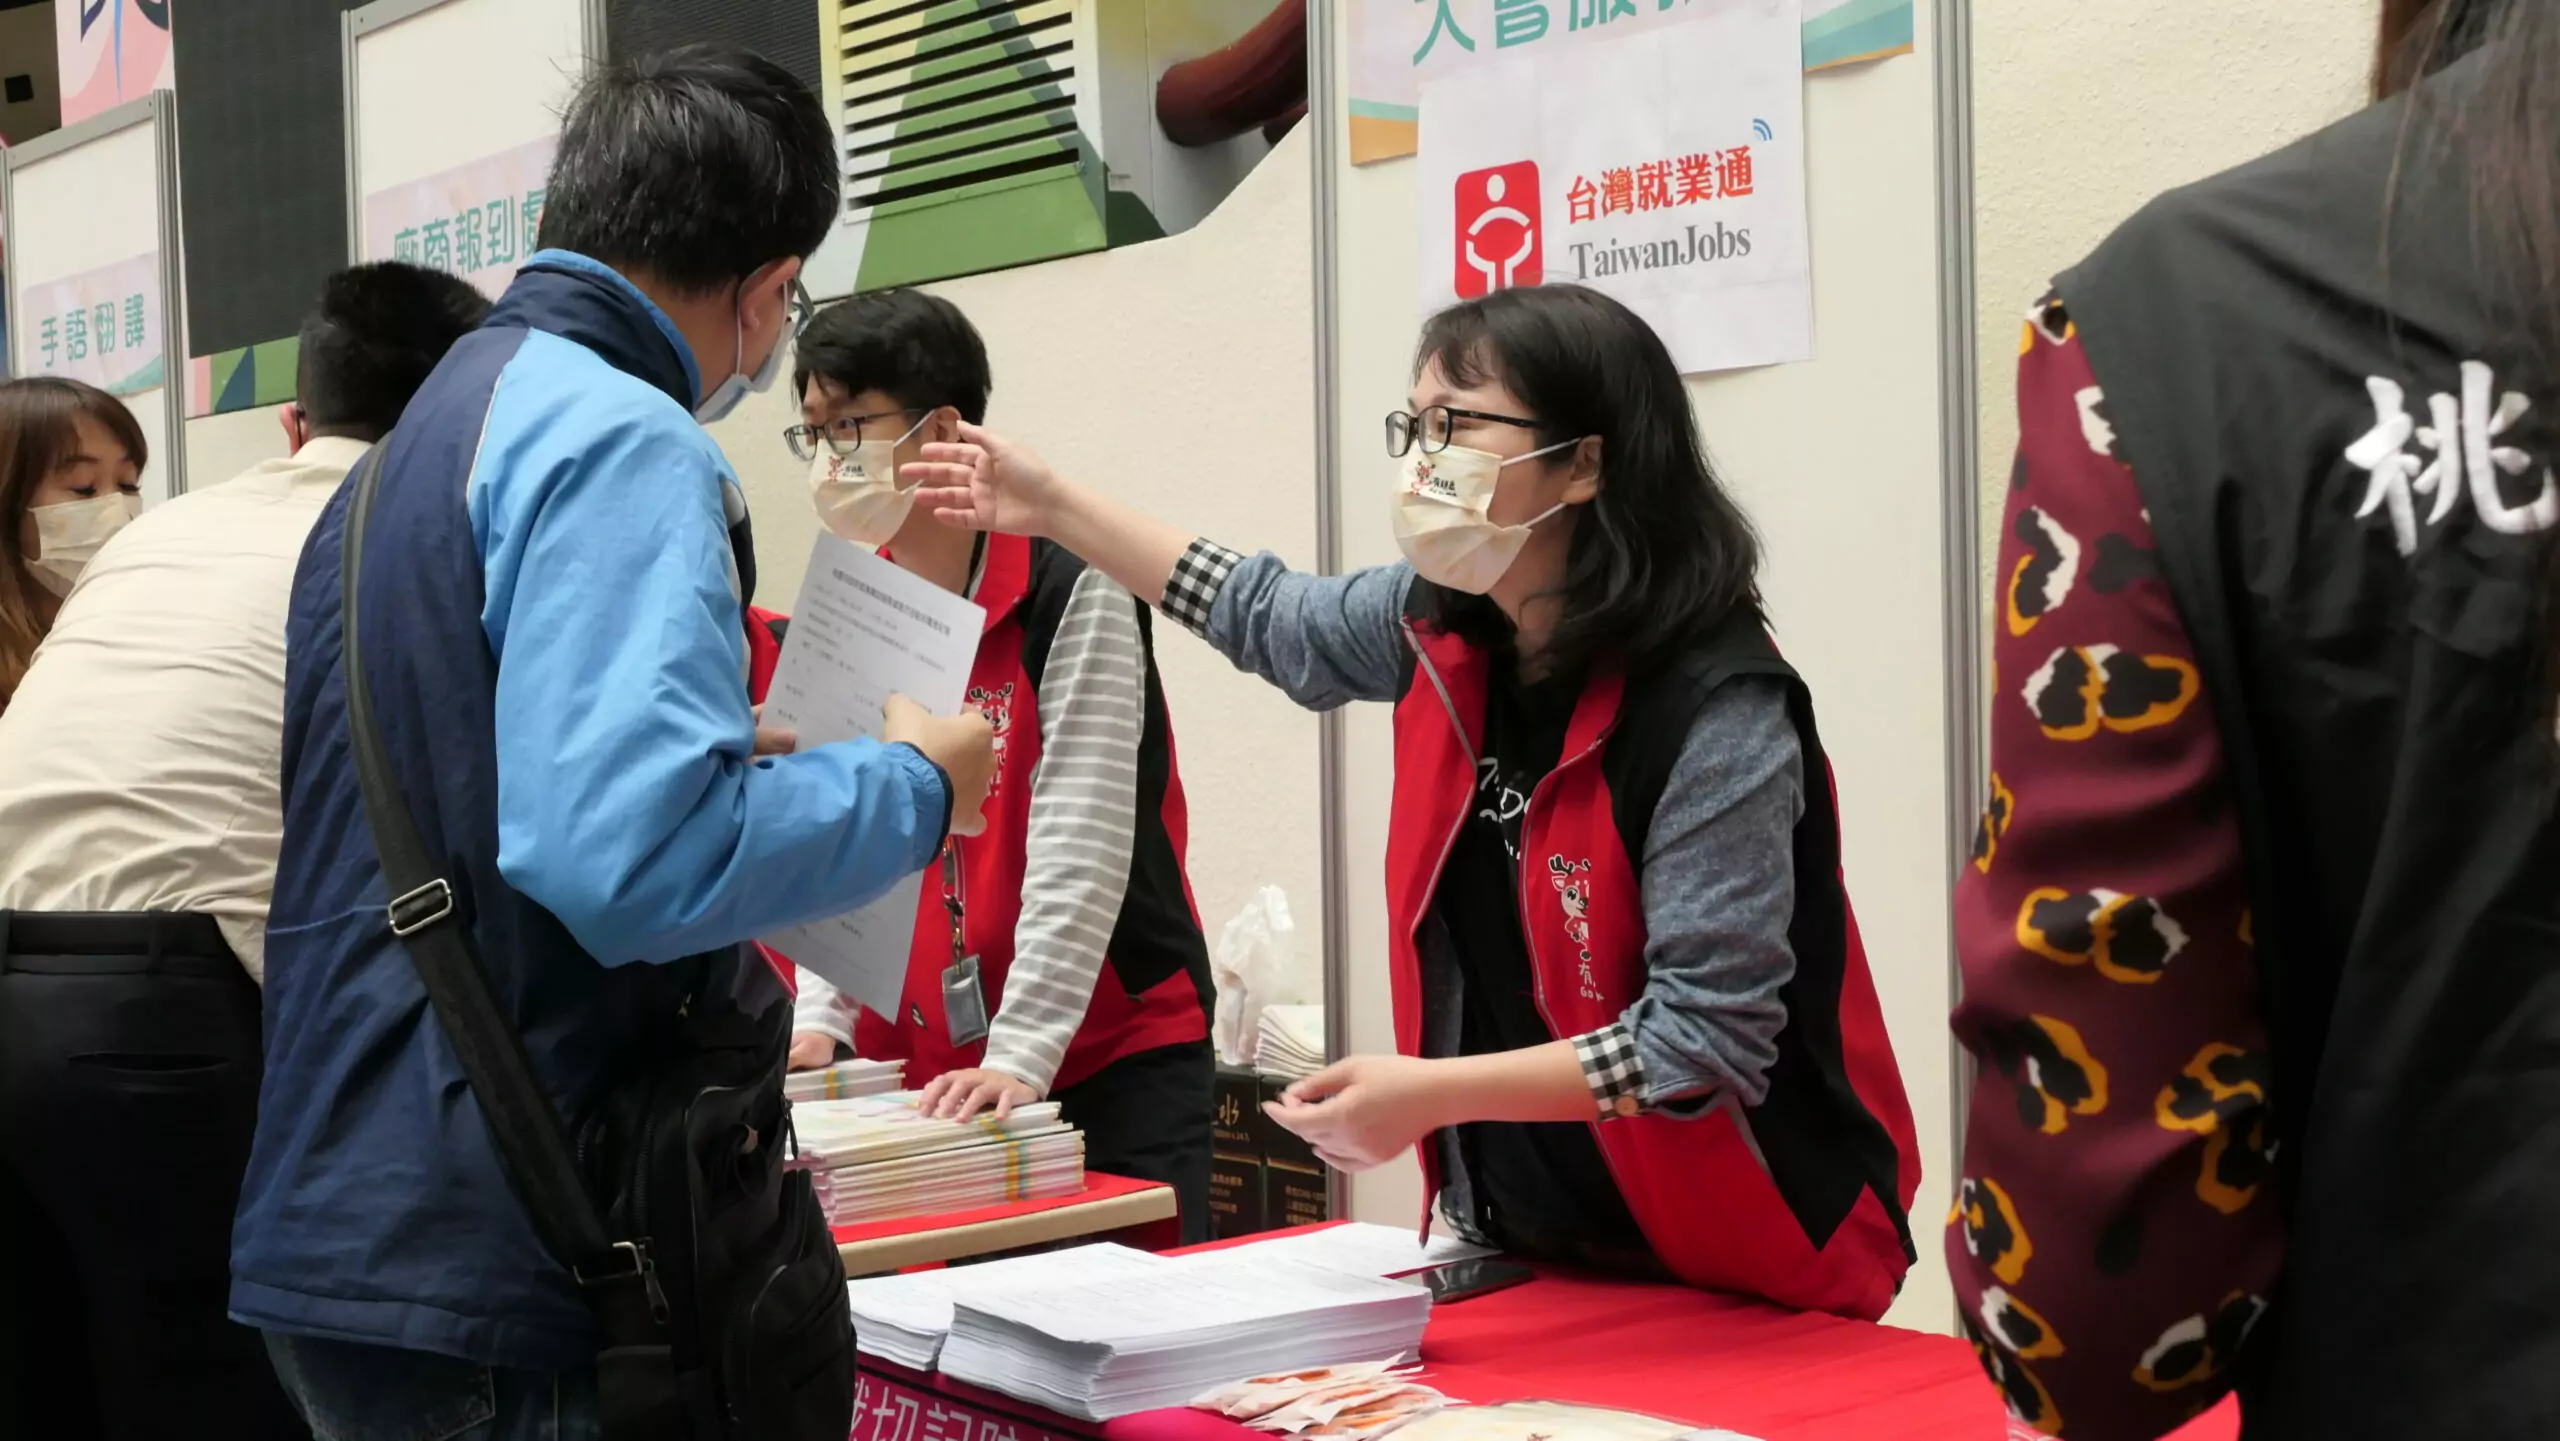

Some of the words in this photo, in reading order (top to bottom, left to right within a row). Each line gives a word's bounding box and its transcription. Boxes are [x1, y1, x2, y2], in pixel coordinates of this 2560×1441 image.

[1566, 145, 1754, 225] 台灣就業通
[1569, 221, 1752, 280] TaiwanJobs
[41, 293, 145, 368] 手語翻譯
[2345, 360, 2560, 559] 桃
